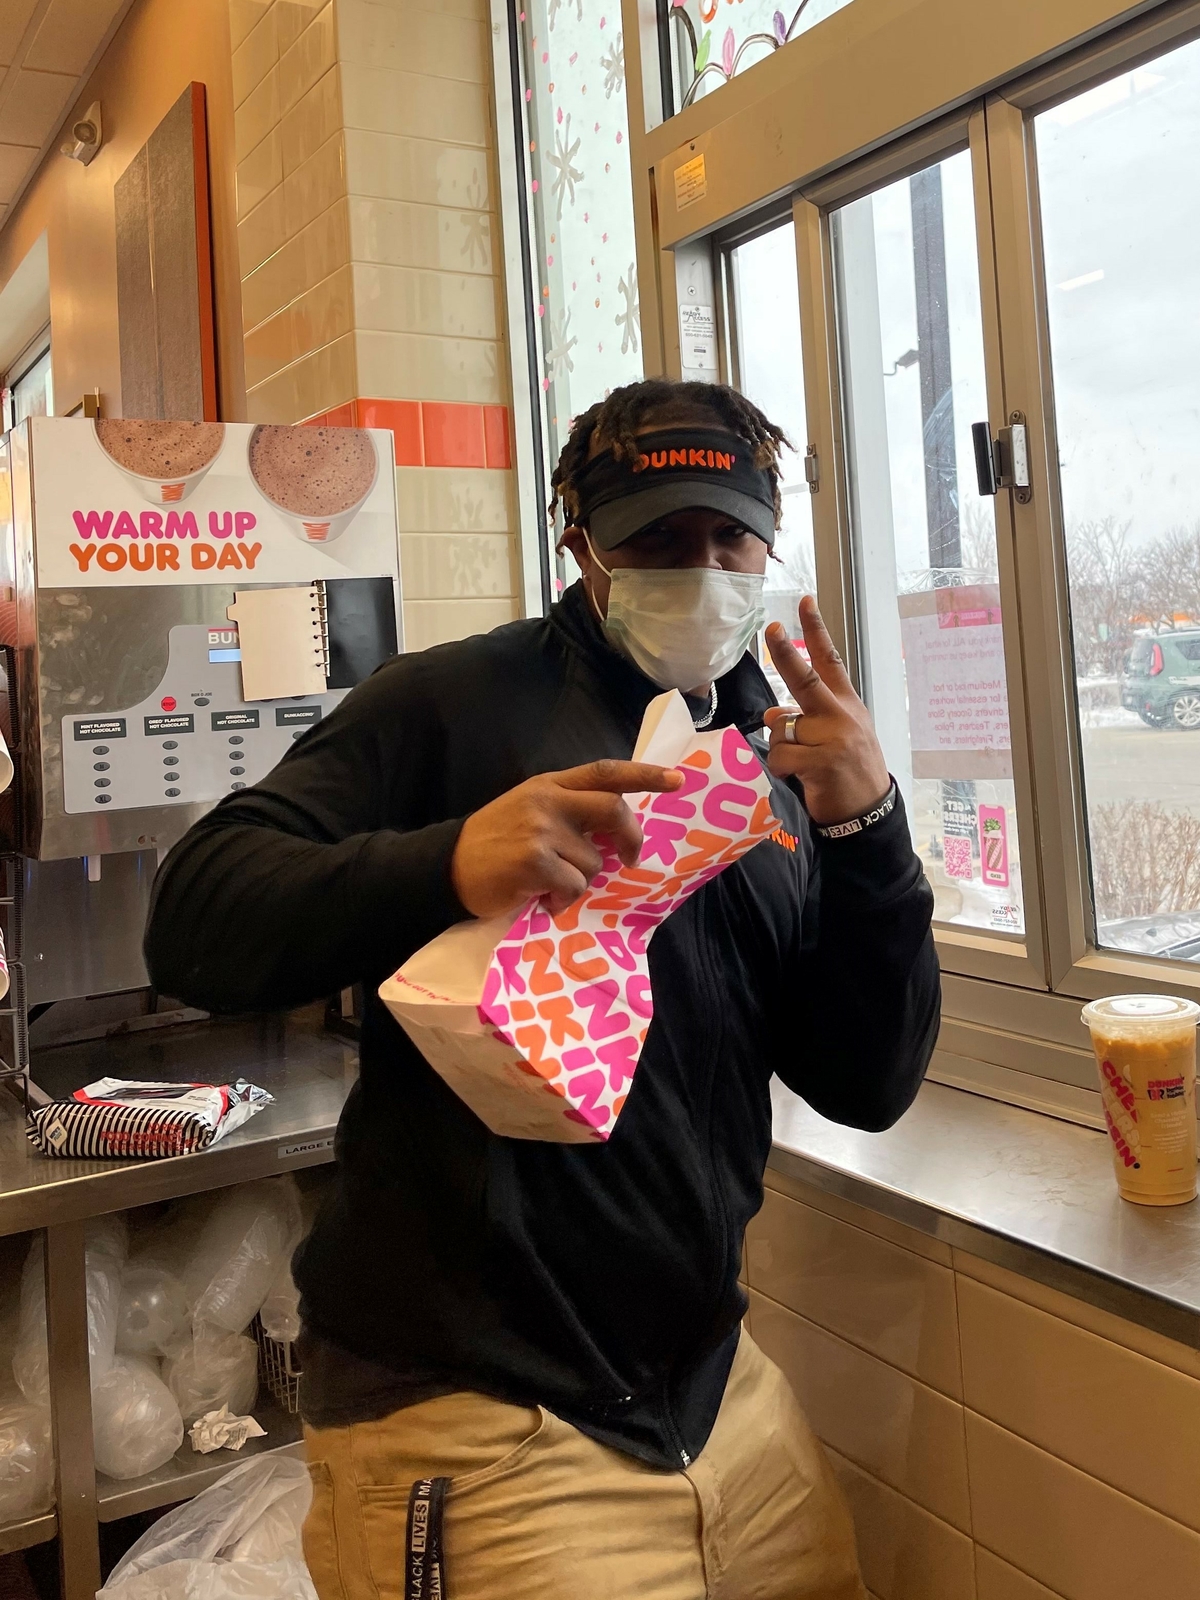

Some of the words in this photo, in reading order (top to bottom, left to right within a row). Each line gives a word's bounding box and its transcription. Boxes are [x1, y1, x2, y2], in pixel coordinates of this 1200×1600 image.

[72, 510, 200, 540] WARM
[208, 510, 257, 540] UP
[69, 543, 180, 572] YOUR
[191, 542, 262, 570] DAY
[863, 799, 894, 826] BLACK
[766, 828, 799, 852] KIN'
[830, 820, 861, 838] LIVES
[101, 1131, 130, 1141] FOOD
[133, 1131, 182, 1143] CONTACT
[285, 1142, 324, 1155] LARGE
[413, 1503, 427, 1548] LIVES
[411, 1554, 424, 1600] LACK
